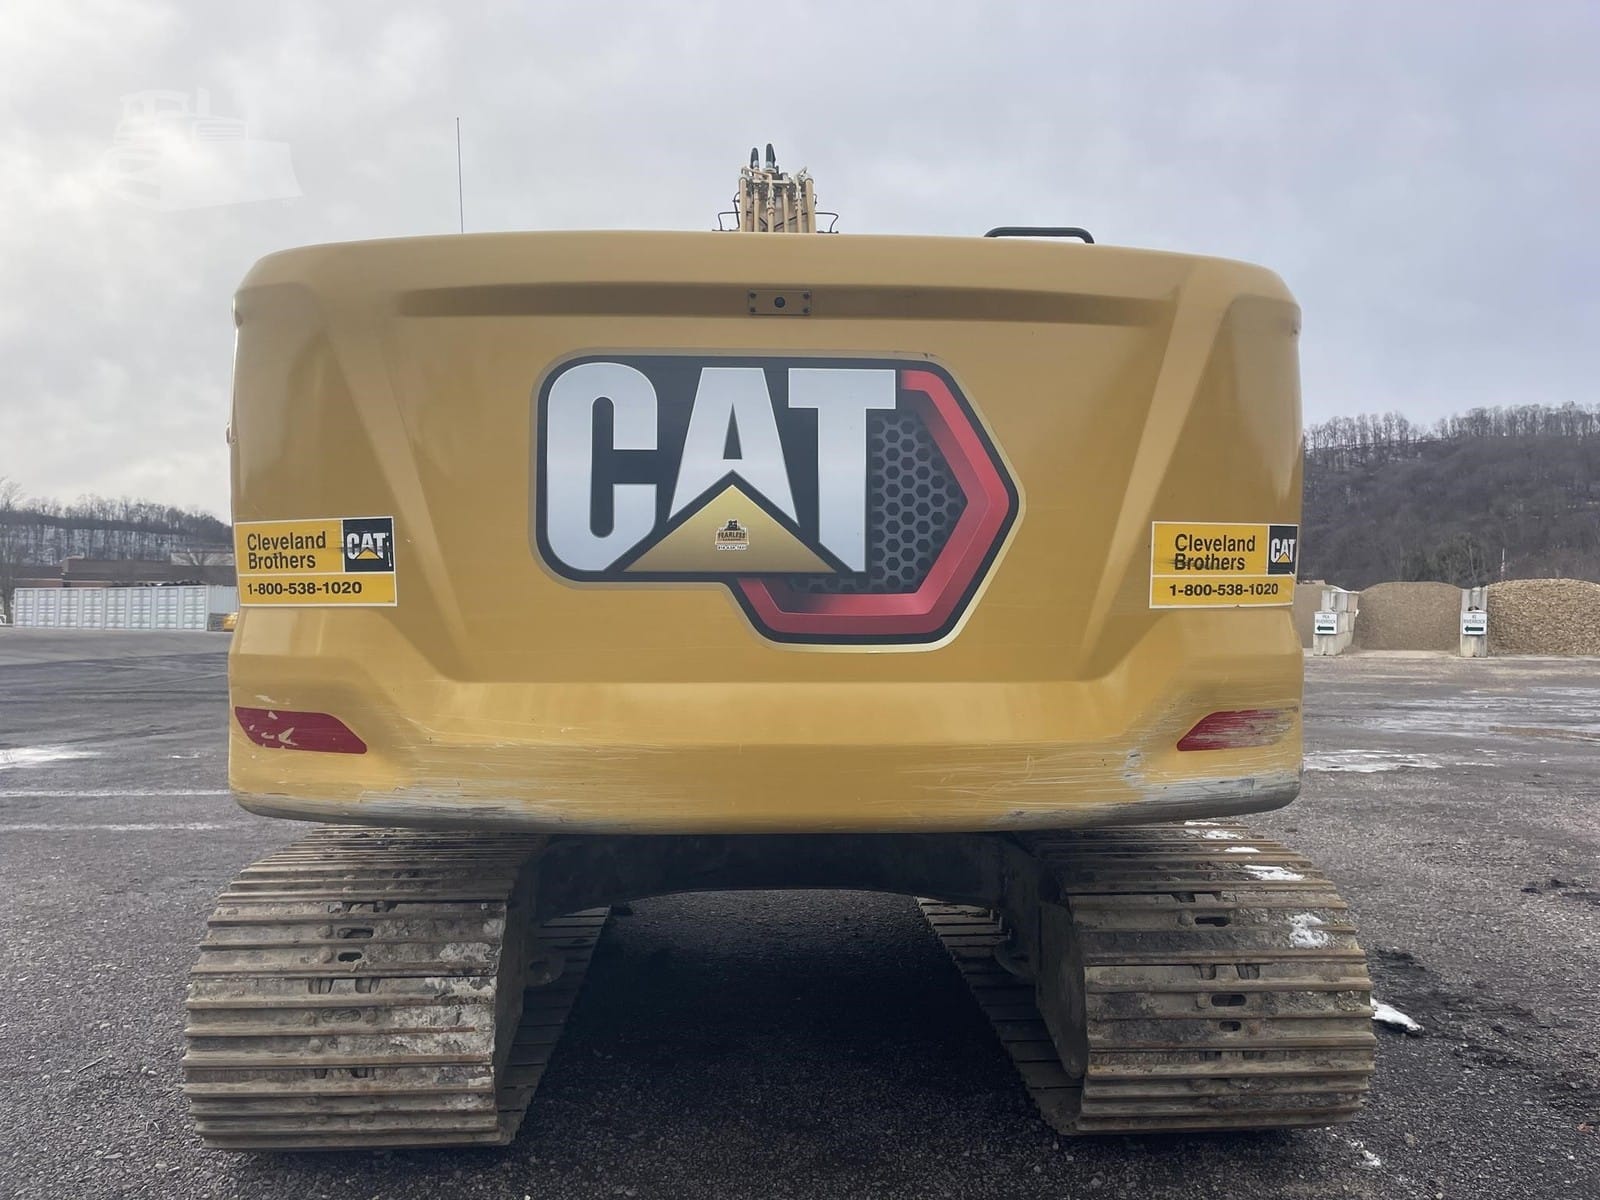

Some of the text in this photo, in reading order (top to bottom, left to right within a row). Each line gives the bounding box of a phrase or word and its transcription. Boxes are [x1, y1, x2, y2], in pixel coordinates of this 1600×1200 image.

[547, 361, 896, 573] CAT
[247, 531, 326, 551] Cleveland
[346, 532, 387, 561] CAT
[1175, 533, 1256, 552] Cleveland
[1270, 538, 1297, 563] CAT
[248, 552, 316, 570] Brothers
[1174, 553, 1245, 571] Brothers
[247, 581, 363, 595] 1-800-538-1020
[1169, 583, 1279, 597] 1-800-538-1020
